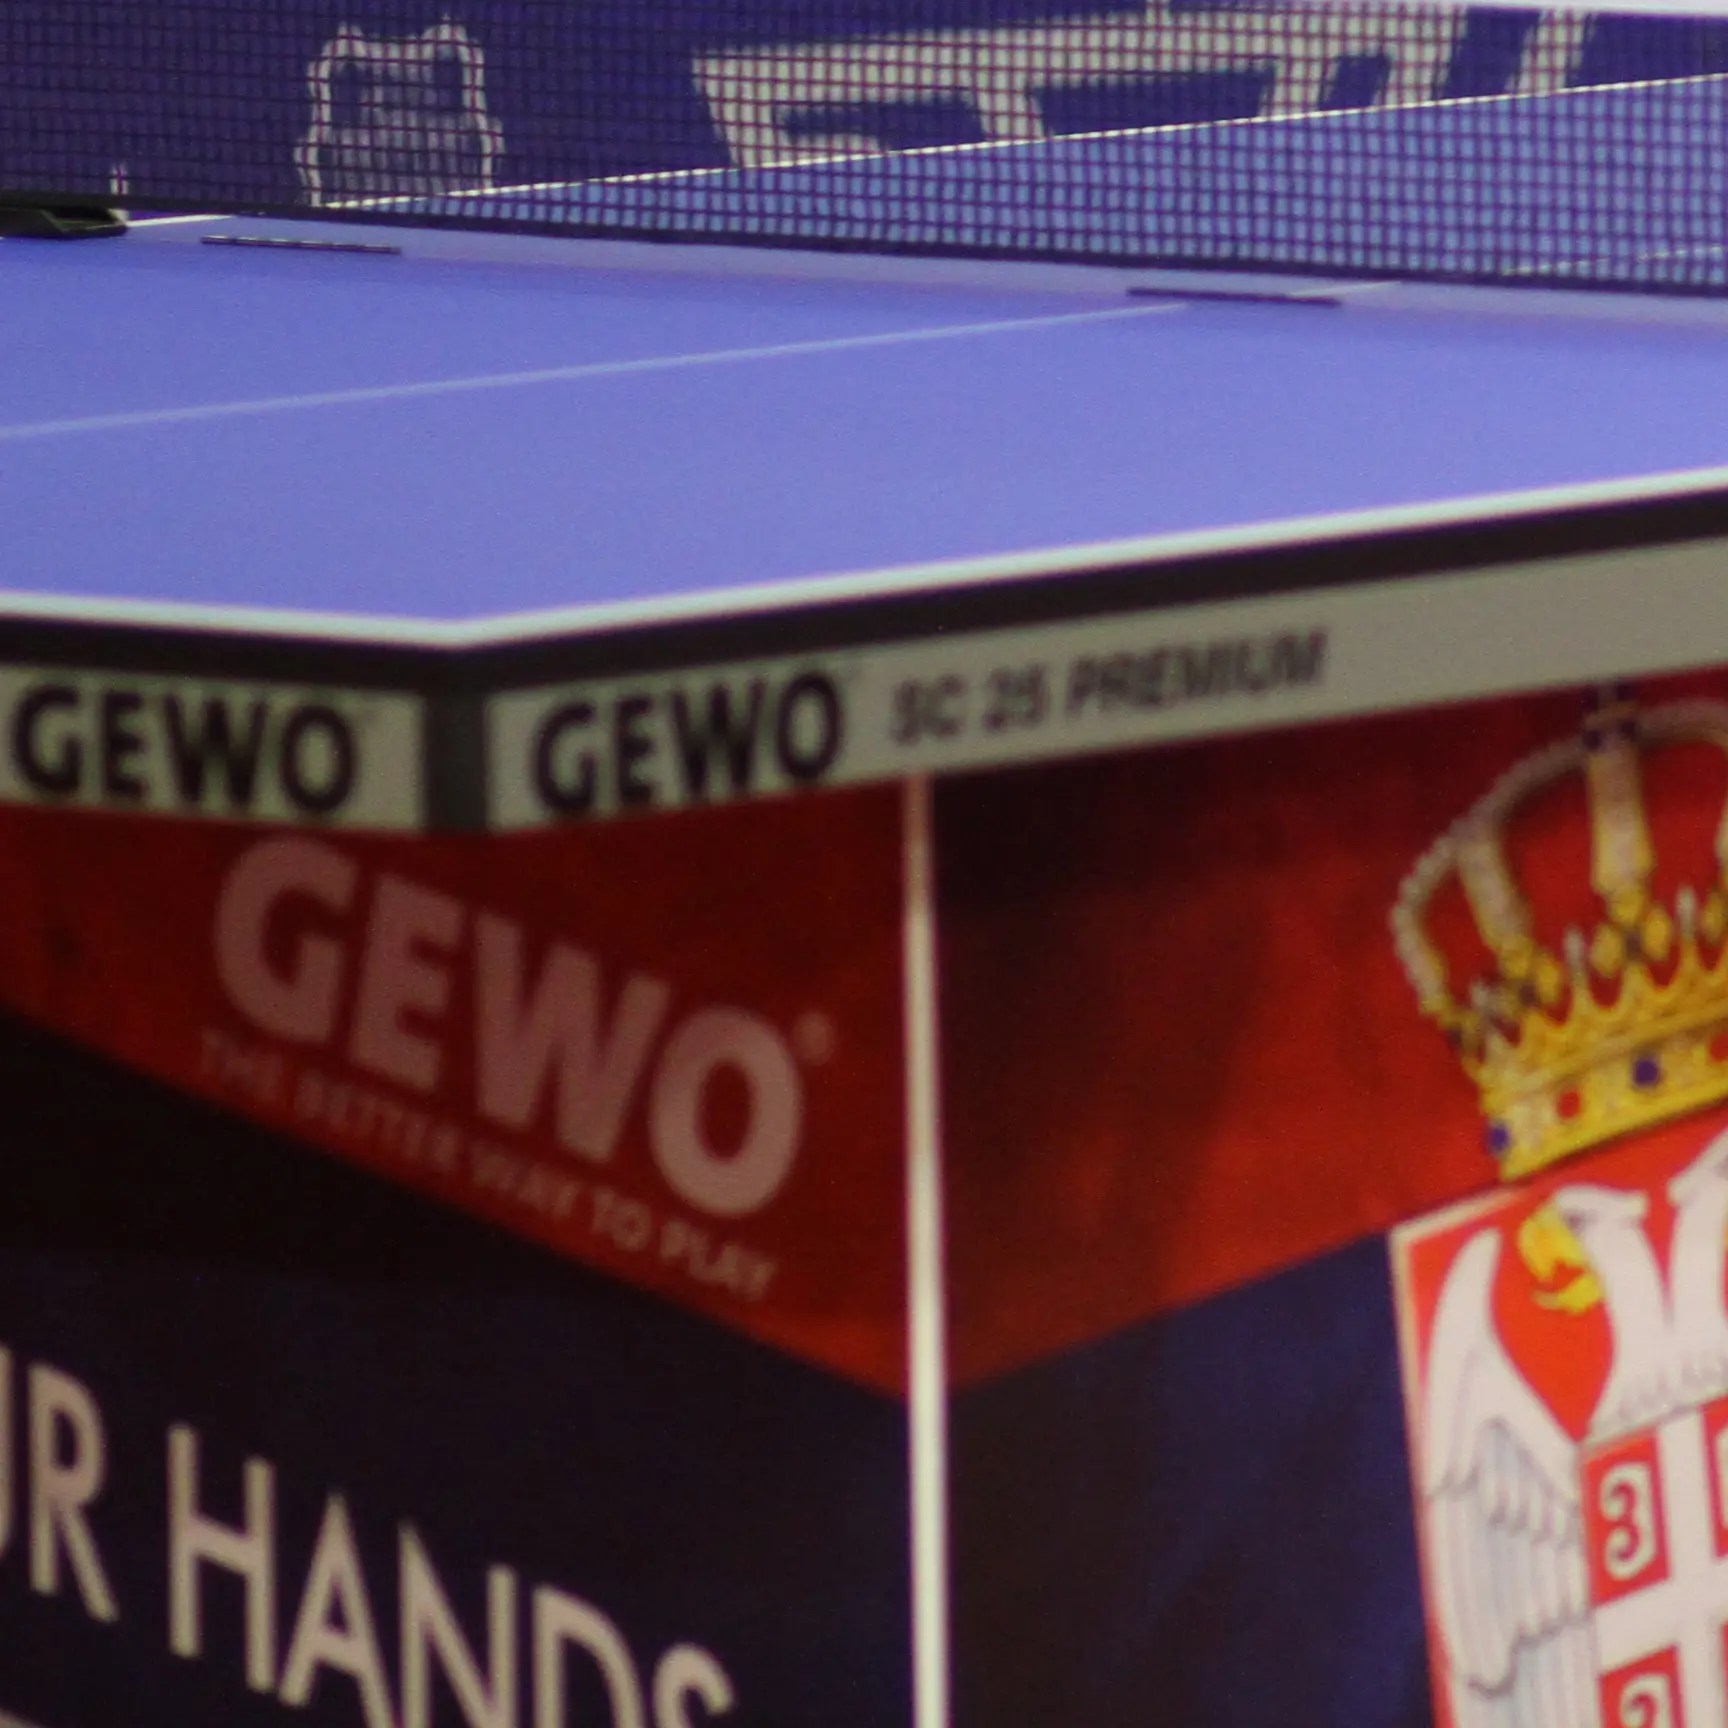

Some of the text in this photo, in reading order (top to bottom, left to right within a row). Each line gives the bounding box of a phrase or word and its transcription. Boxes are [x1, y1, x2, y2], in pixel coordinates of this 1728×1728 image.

[13, 683, 357, 813] GEWO
[532, 673, 845, 811] GEWO
[1065, 625, 1329, 715] PREMIUM
[213, 835, 803, 1217] GEWO
[0, 1345, 119, 1623] R
